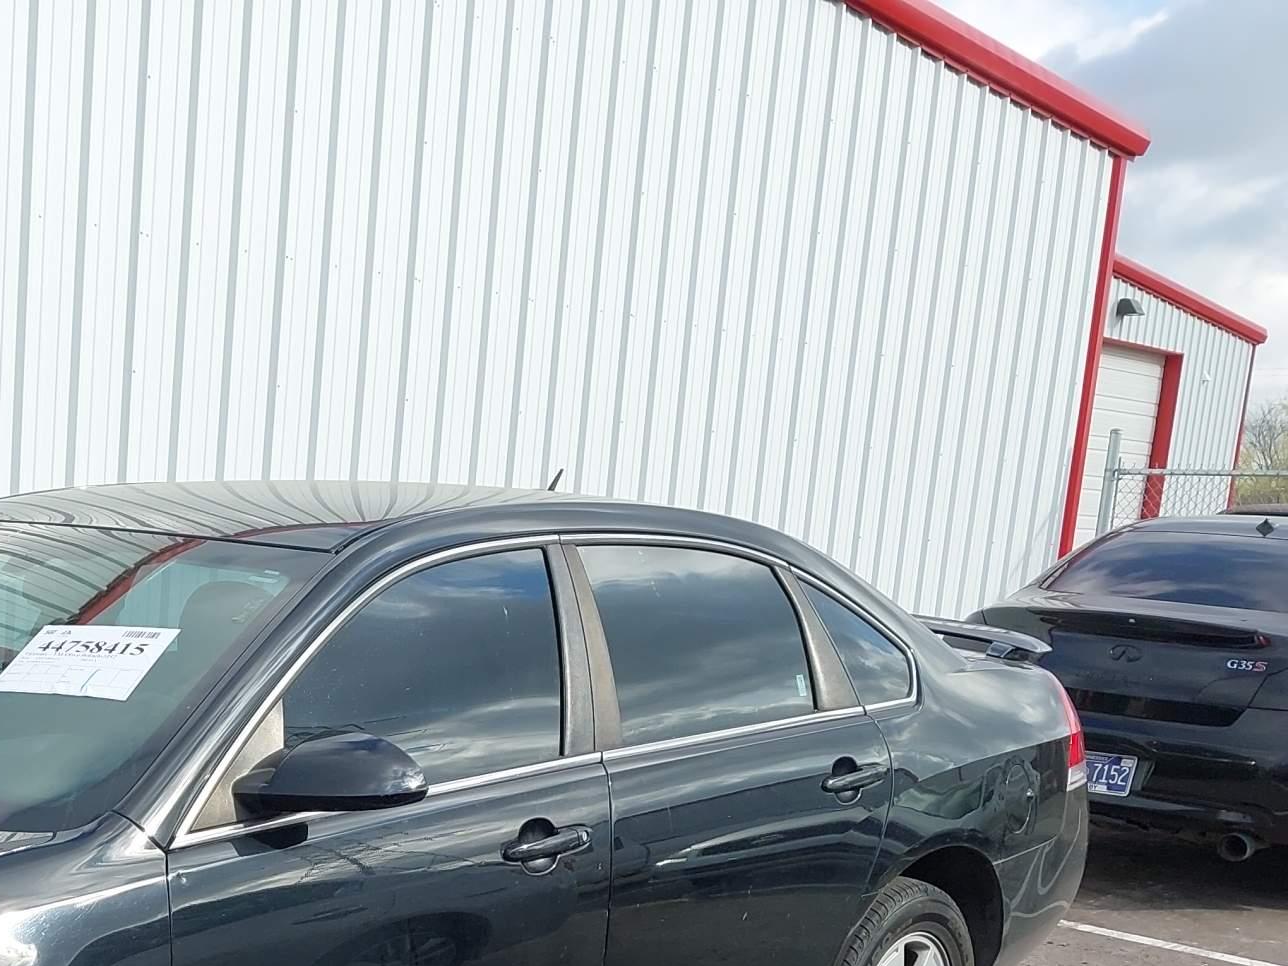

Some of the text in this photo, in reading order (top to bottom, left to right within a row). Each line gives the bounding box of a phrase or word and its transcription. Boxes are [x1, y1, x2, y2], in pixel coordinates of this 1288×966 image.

[38, 640, 149, 656] 44758415
[1226, 659, 1268, 672] G35S
[1092, 763, 1130, 786] 7152
